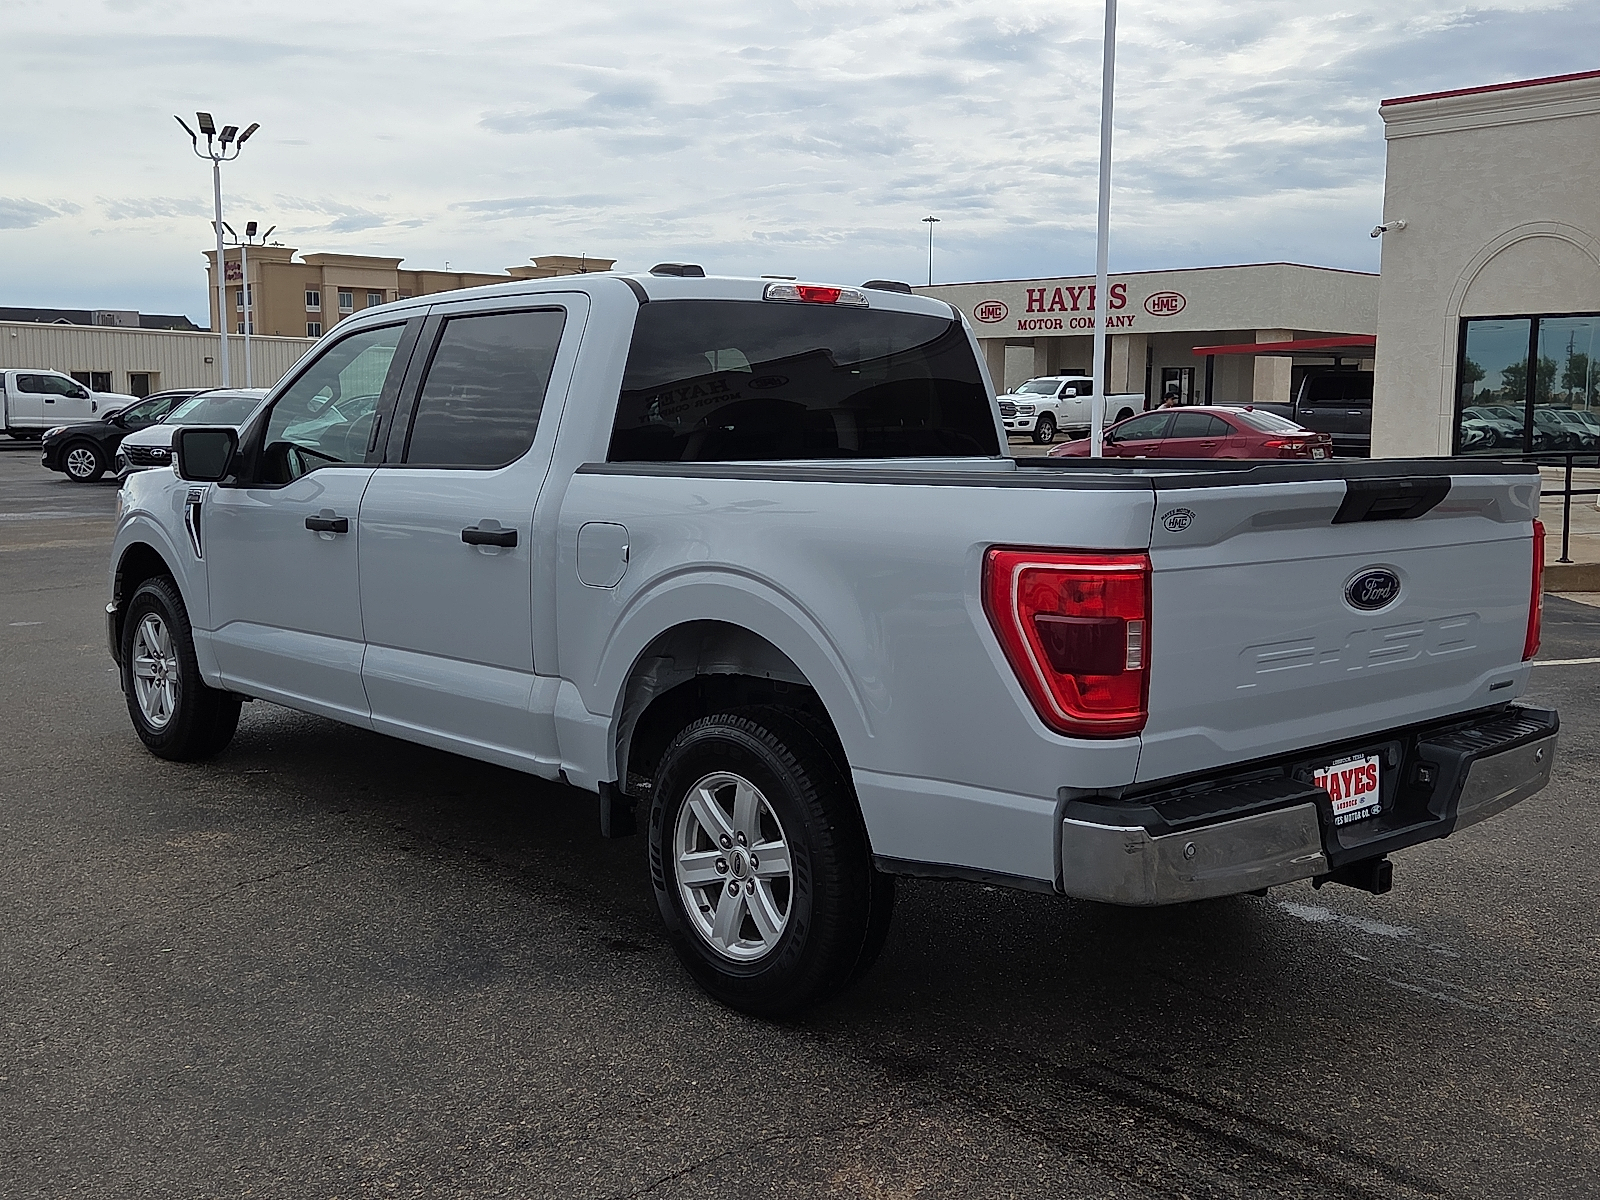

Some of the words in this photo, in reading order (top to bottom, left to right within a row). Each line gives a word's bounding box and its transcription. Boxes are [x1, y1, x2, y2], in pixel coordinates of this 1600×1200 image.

[1017, 318, 1063, 331] MOTOR
[1069, 315, 1136, 330] COMANY
[1362, 578, 1393, 600] Ford
[1237, 611, 1482, 689] F-150
